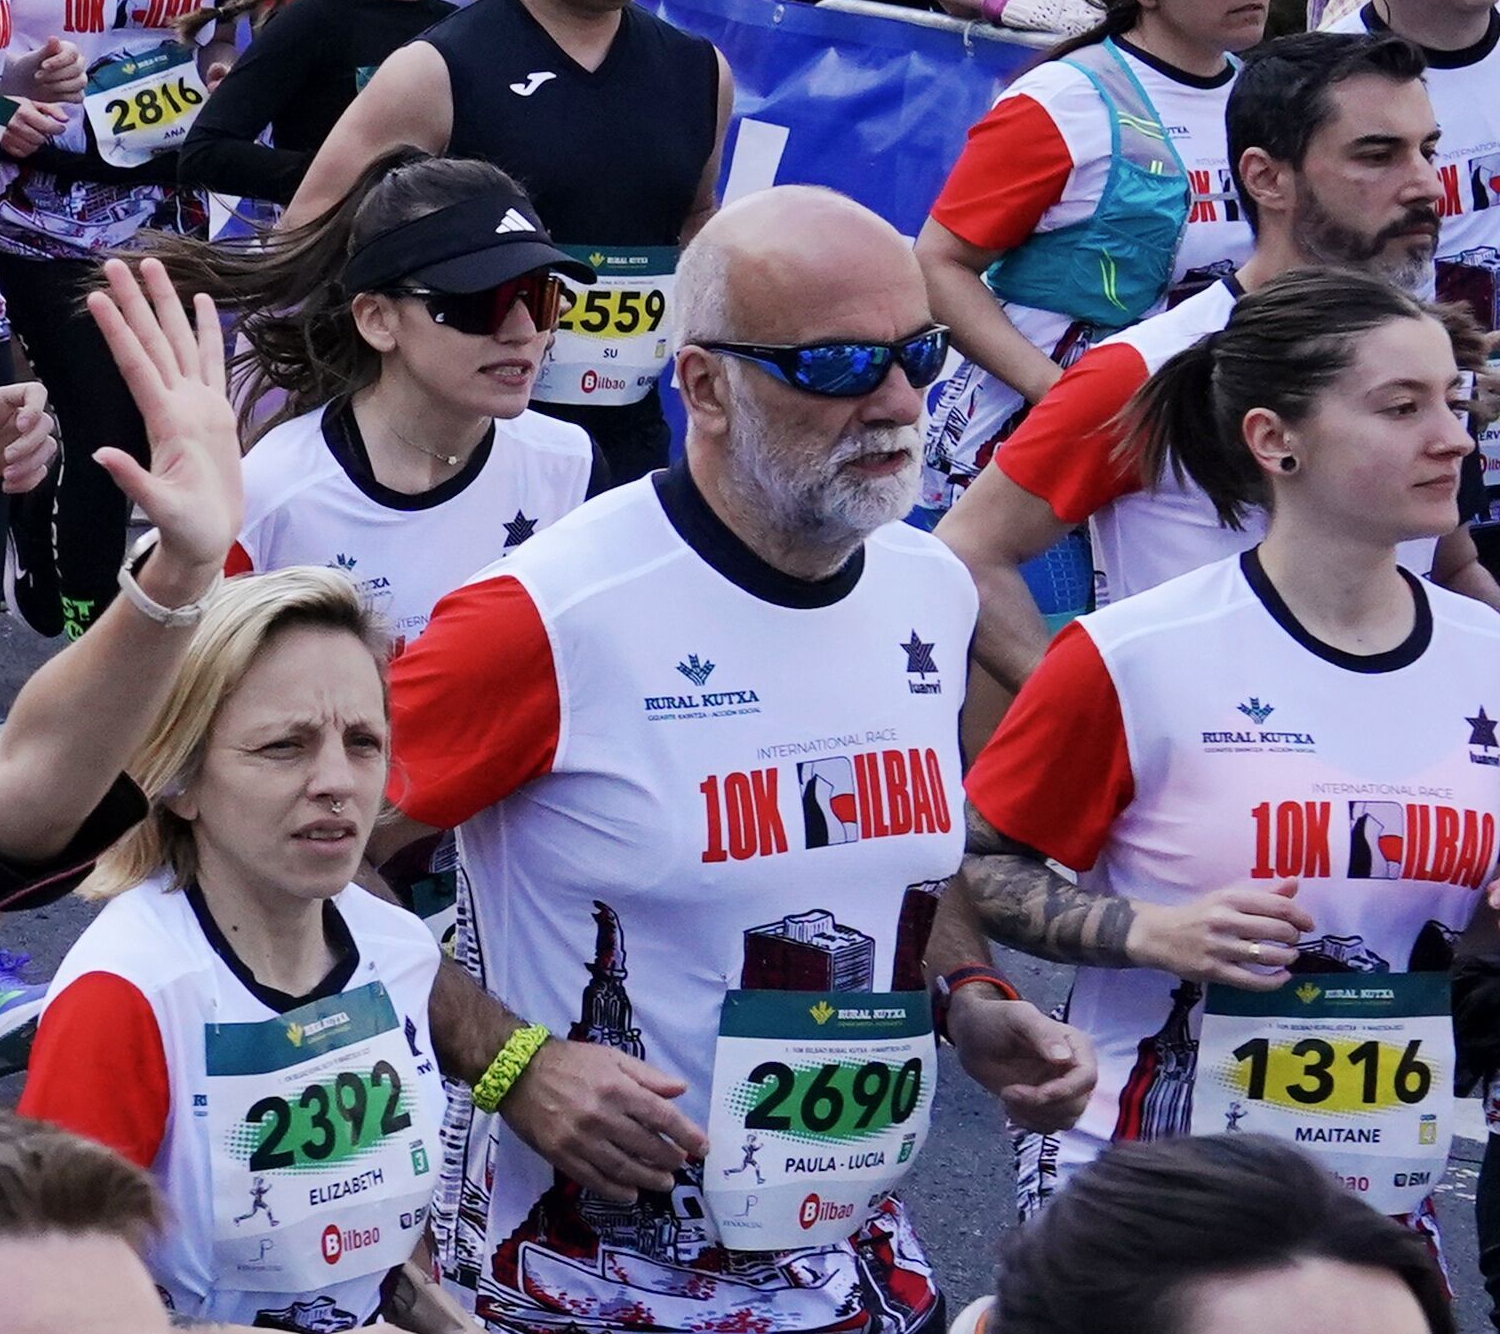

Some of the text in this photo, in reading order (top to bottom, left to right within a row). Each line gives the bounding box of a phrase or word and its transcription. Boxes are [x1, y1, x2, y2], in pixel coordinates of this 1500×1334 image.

[104, 77, 203, 136] 2816
[163, 126, 186, 139] ANA
[603, 347, 618, 359] SU
[582, 371, 626, 393] Bilbao
[644, 690, 761, 711] RURAL KUTXA
[755, 727, 899, 761] INTERNATIONAL RACE
[1201, 731, 1317, 746] RURAL KUTXA
[700, 768, 788, 864] 10K
[1251, 800, 1331, 880] 10K
[1233, 1038, 1432, 1104] 1316
[744, 1057, 923, 1133] 2690
[245, 1061, 413, 1173] 2392
[1295, 1127, 1381, 1148] MAITANE
[783, 1151, 887, 1174] PAULA LUCIA
[307, 1167, 386, 1208] ELIZABETH
[322, 1224, 382, 1264] Bilbao
